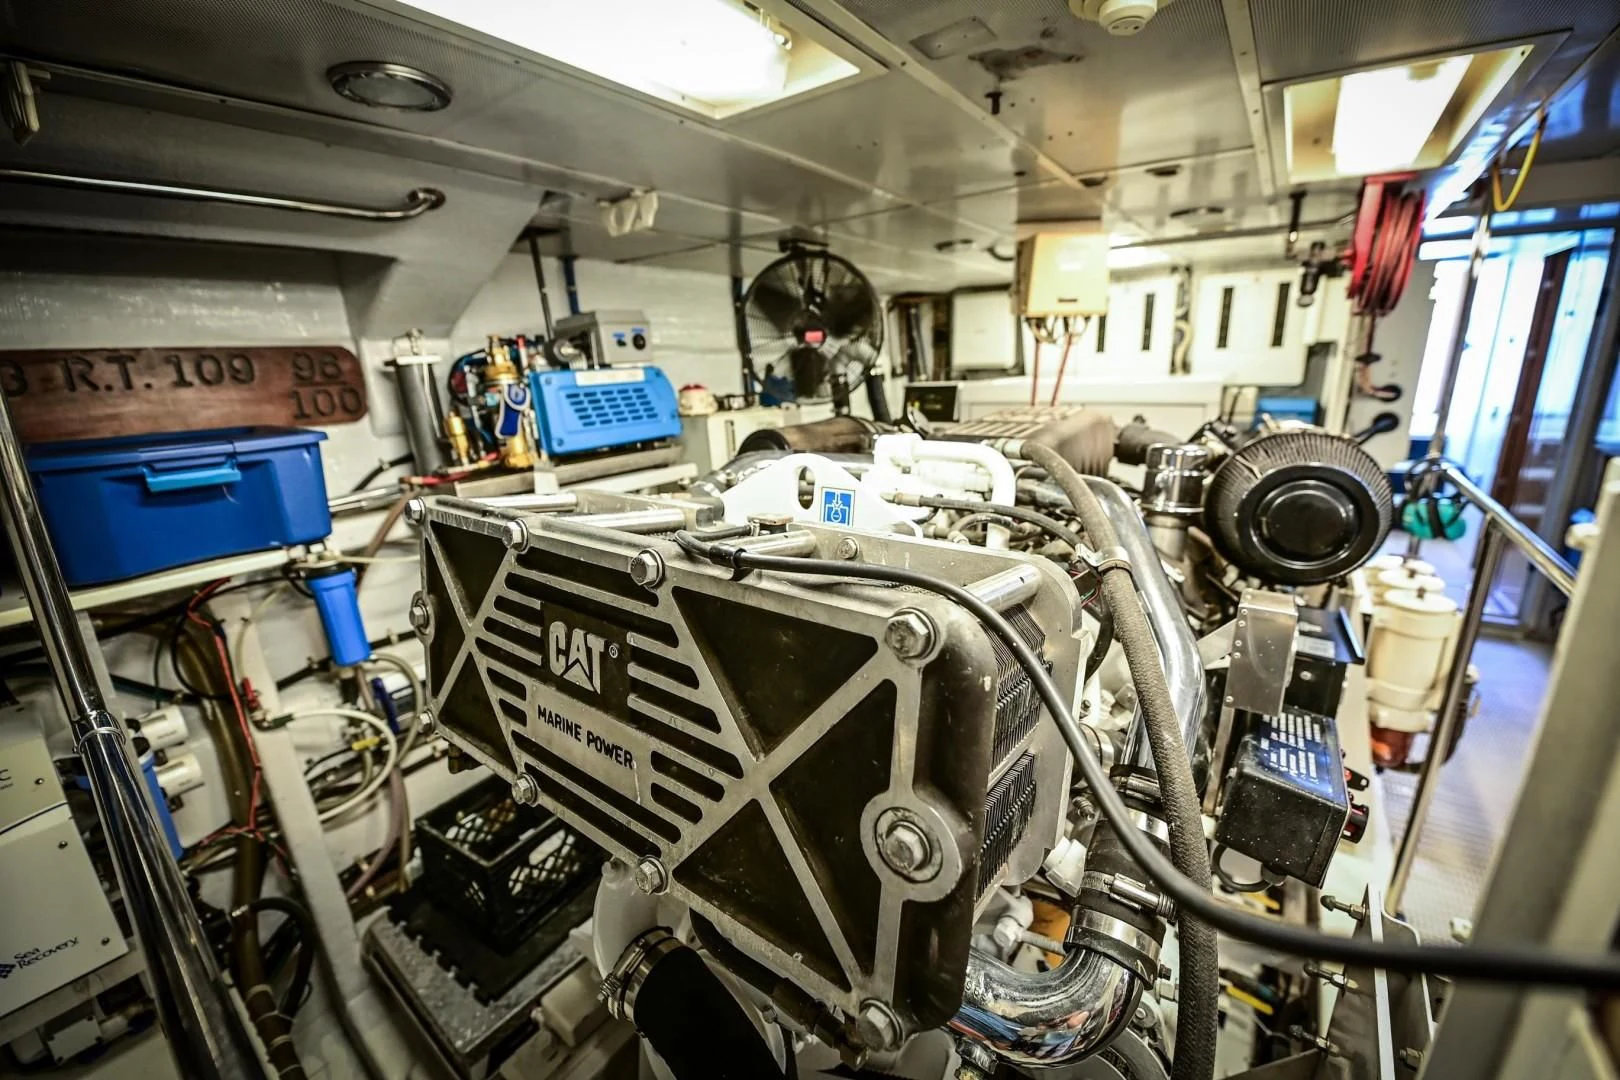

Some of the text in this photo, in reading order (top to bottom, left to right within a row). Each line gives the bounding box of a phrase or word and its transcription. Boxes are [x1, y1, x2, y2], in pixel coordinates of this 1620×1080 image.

[60, 354, 153, 393] R.T.
[165, 352, 256, 388] 109
[290, 386, 362, 420] 100
[537, 704, 633, 770] MARINE POWER
